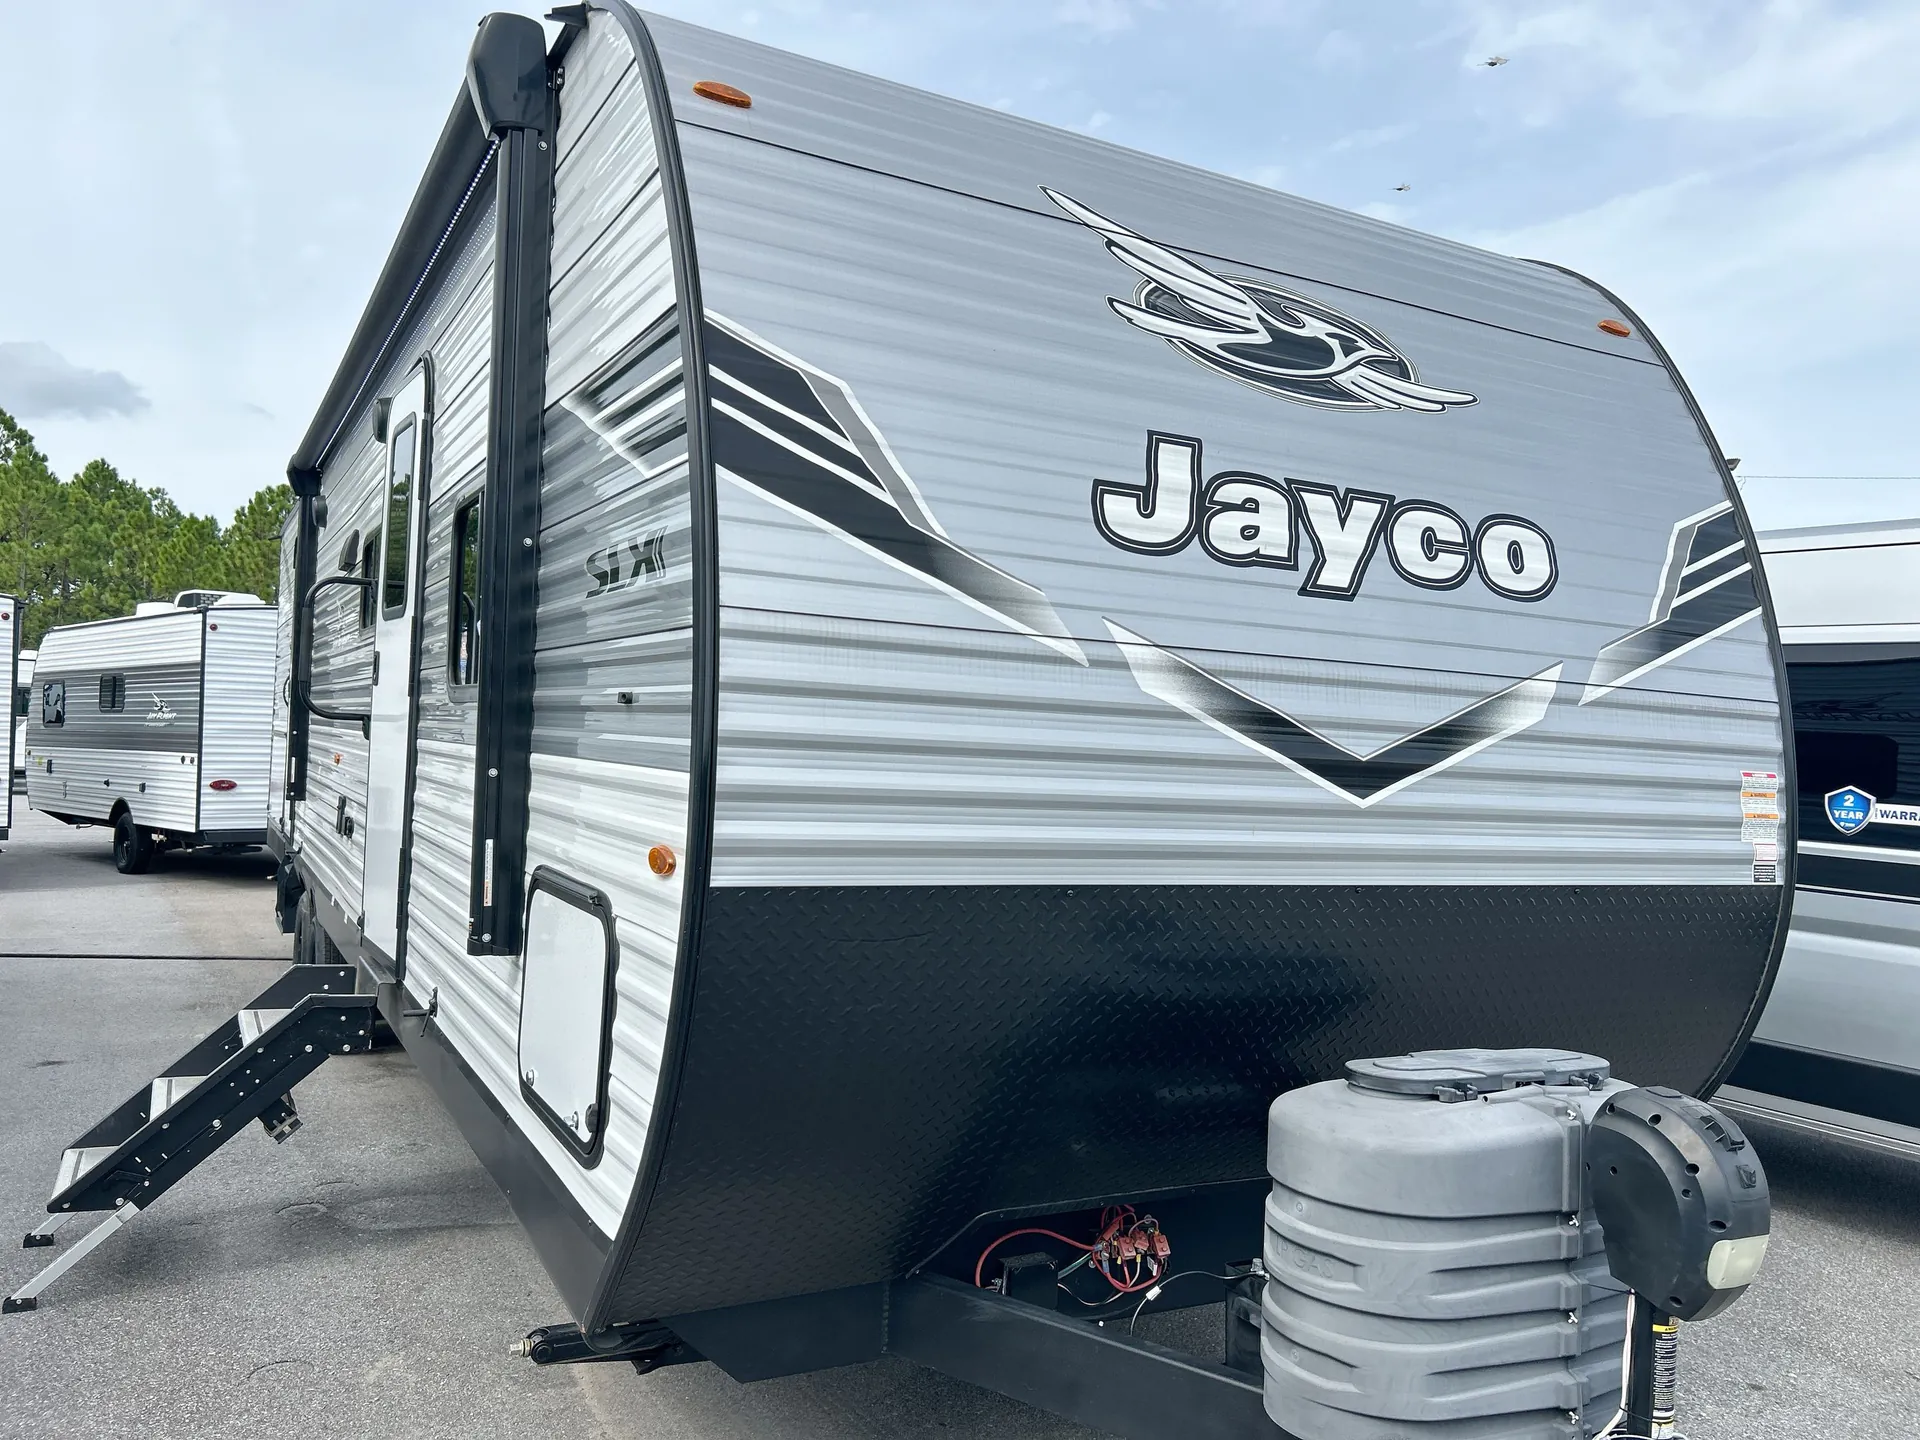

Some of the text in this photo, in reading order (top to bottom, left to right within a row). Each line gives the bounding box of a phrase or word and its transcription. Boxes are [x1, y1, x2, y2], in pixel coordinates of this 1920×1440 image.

[1092, 429, 1559, 602] Jayco
[585, 525, 668, 598] SLX
[1843, 794, 1855, 807] 2
[1833, 809, 1864, 820] YEAR
[1879, 809, 1920, 821] WARR
